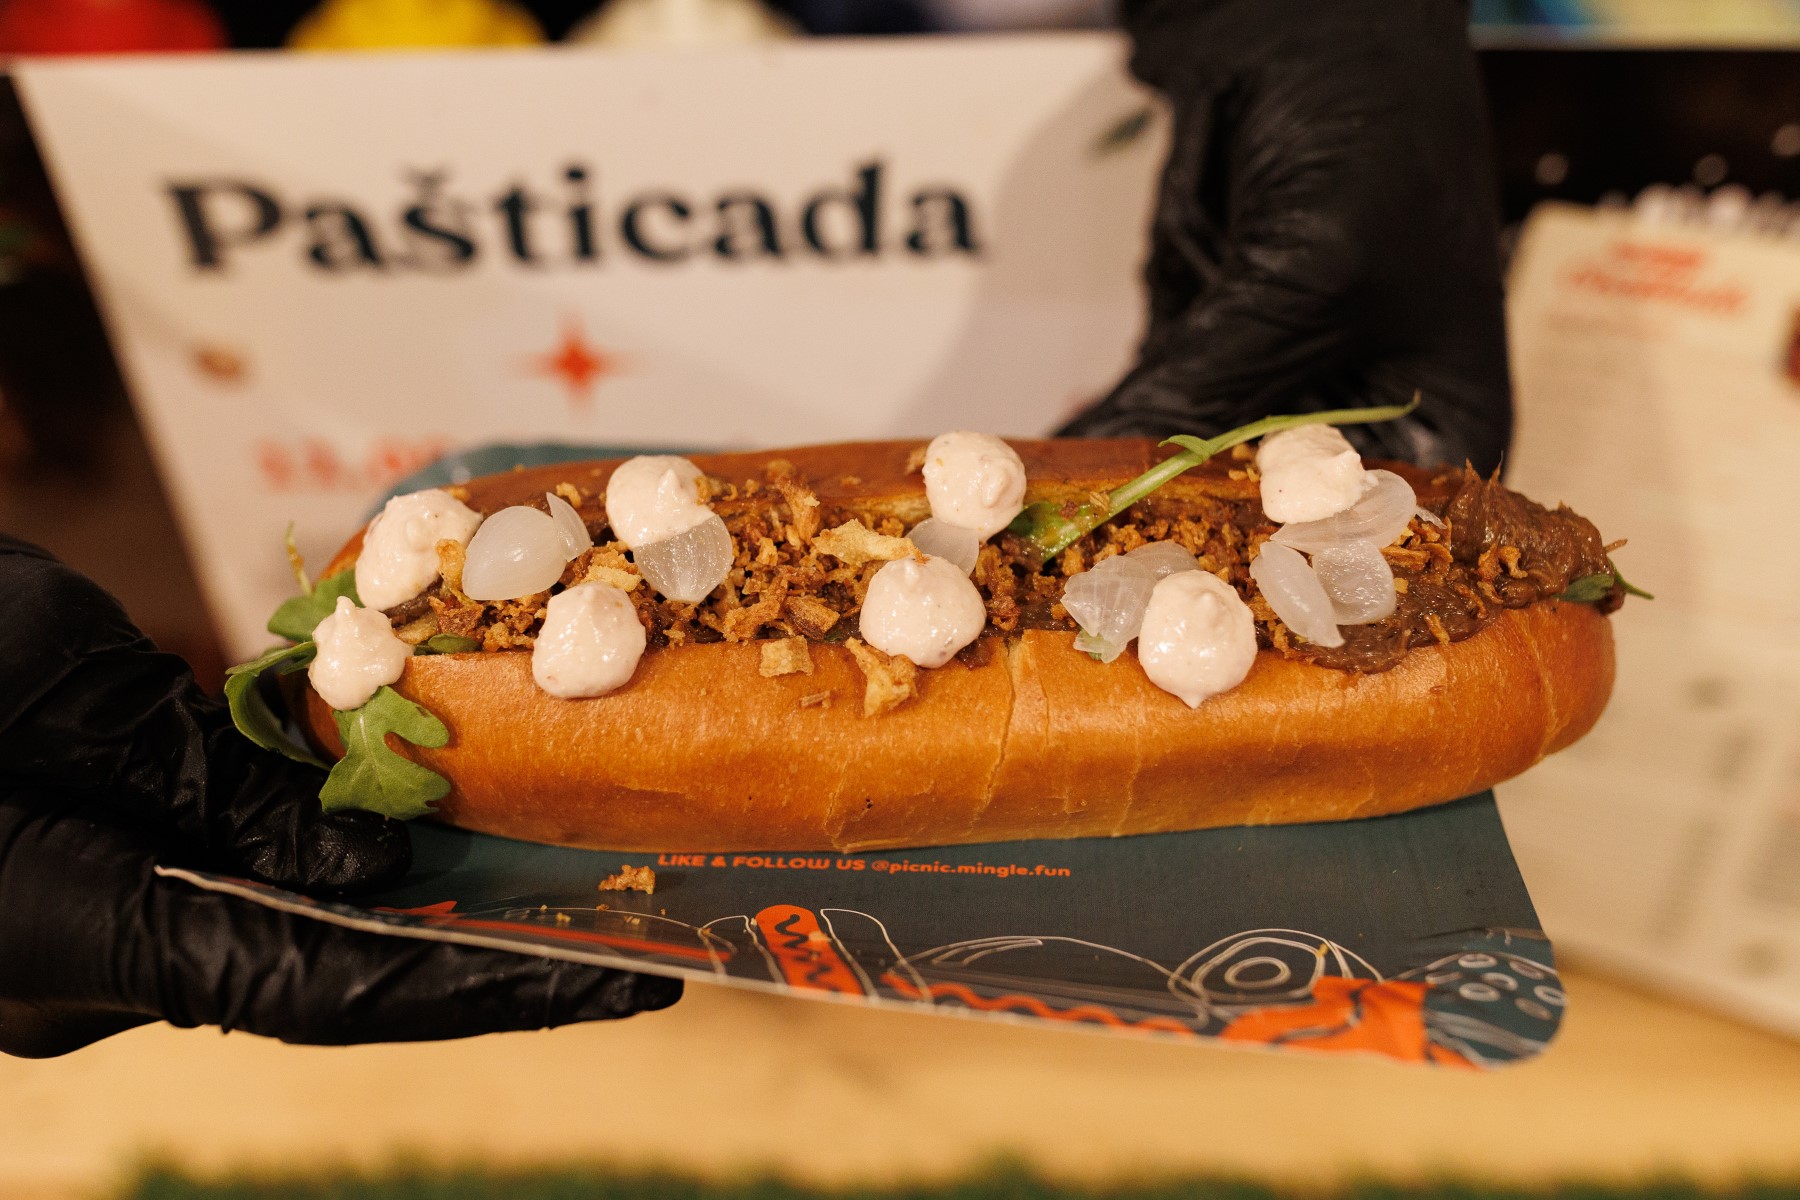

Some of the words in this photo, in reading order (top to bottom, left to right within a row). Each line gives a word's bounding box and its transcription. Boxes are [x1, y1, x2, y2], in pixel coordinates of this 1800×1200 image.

[163, 158, 985, 276] Pašticada
[657, 853, 707, 867] LIKE
[711, 855, 727, 868] &
[732, 855, 831, 870] FOLLOW
[835, 858, 866, 871] US
[871, 860, 1071, 878] @picnic.mingle.fun
